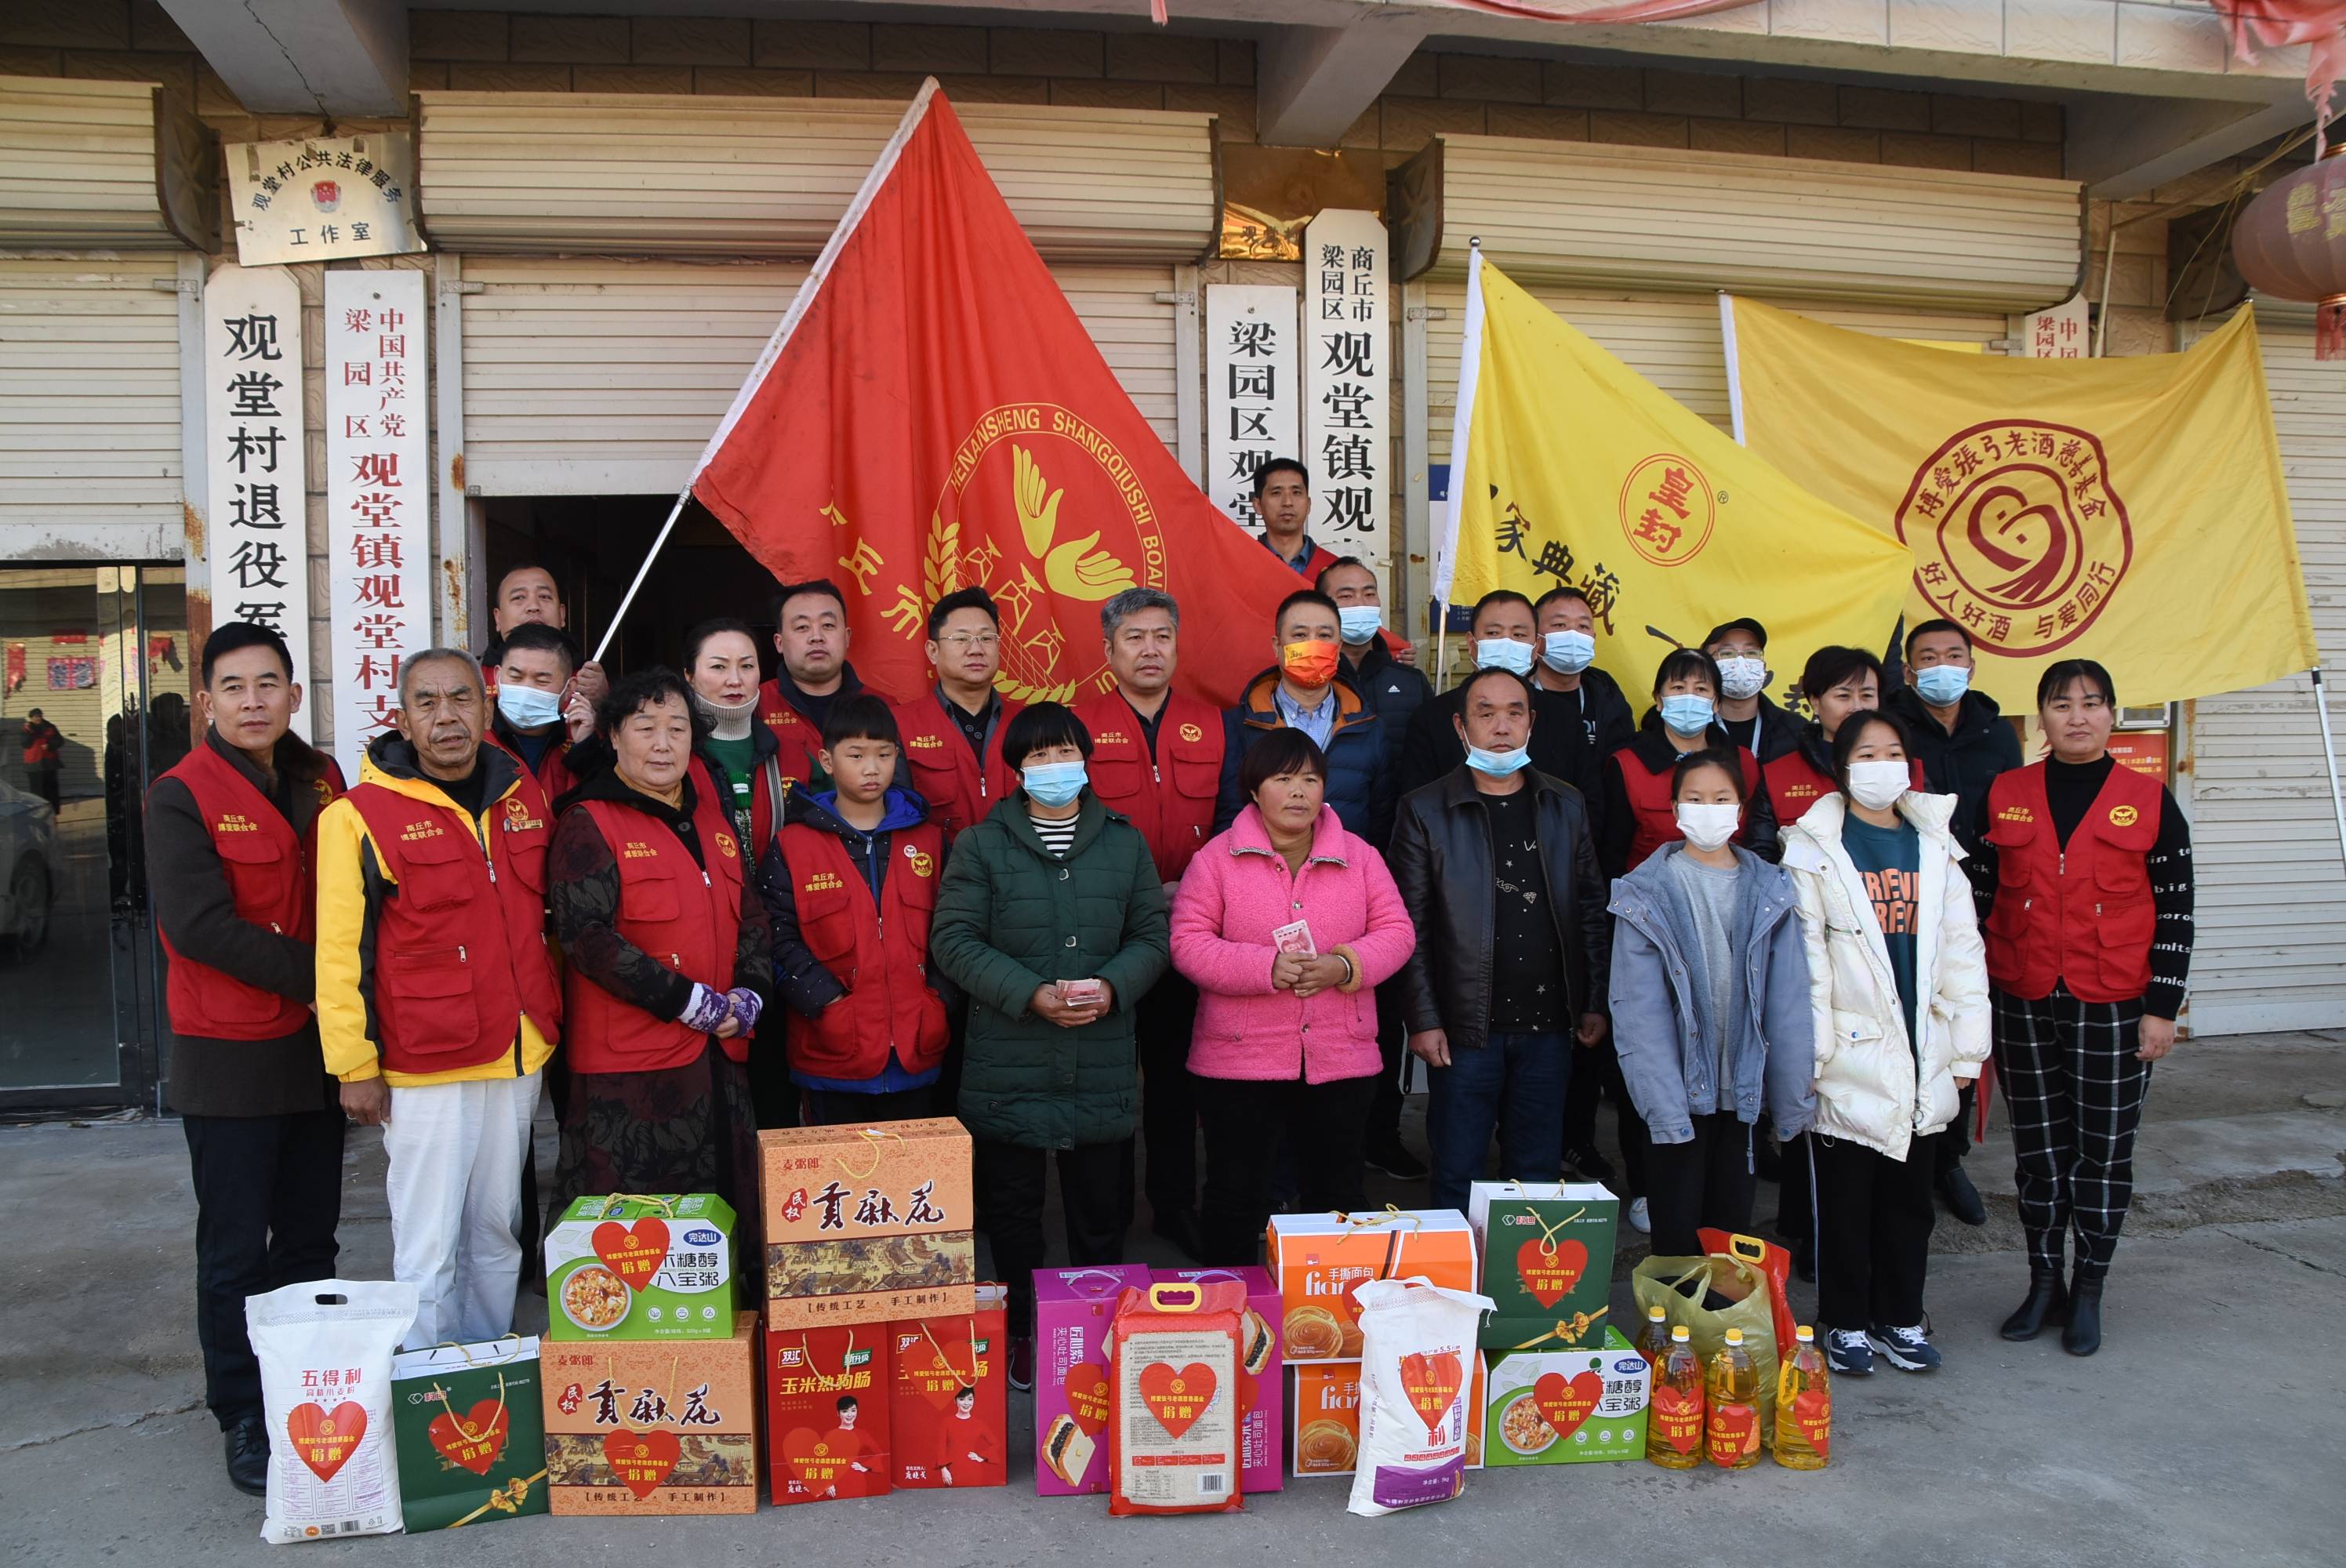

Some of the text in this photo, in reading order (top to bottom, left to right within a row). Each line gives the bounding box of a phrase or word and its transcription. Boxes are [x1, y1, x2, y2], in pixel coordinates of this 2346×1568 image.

[251, 150, 404, 211] 观堂村公共法律服务
[290, 222, 371, 245] 工作室
[1320, 244, 1346, 321] 梁园区
[1349, 246, 1375, 322] 商丘市
[343, 308, 372, 439] 梁园区
[379, 308, 406, 438] 中国共产党
[1320, 330, 1376, 557] 观堂镇观
[950, 408, 1164, 588] HENANSHENG SHANGQIUSHI BOAI
[1632, 467, 1696, 554] 皇封
[1490, 483, 1621, 637] 家典藏
[349, 452, 406, 758] 观堂镇观堂村支
[1920, 561, 2116, 642] 好人好酒 与爱同行
[910, 740, 943, 749] 博爱联合会
[401, 827, 445, 842] 博爱联合会
[405, 820, 432, 833] 商丘市
[805, 880, 844, 892] 博爱联合会
[812, 873, 835, 882] 商丘市
[784, 1191, 807, 1220] 民权
[812, 1180, 946, 1231] 贡麻花
[688, 1232, 717, 1243] 完达山
[621, 1259, 651, 1275] 捐赠
[657, 1271, 720, 1287] 八宝粥
[1536, 1279, 1563, 1291] 捐赠
[557, 1354, 594, 1367] 麦粥郎
[781, 1349, 801, 1363] 双汇
[1618, 1361, 1643, 1371] 完达山
[301, 1367, 361, 1387] 五得利
[779, 1370, 872, 1395] 玉米热狗肠
[927, 1379, 955, 1392] 捐赠
[561, 1384, 582, 1412] 民权
[587, 1379, 721, 1426] 贡麻花
[1421, 1396, 1443, 1410] 捐赠
[1078, 1403, 1109, 1422] 捐赠
[1163, 1405, 1192, 1419] 捐赠
[1553, 1410, 1581, 1422] 捐赠
[1253, 1410, 1264, 1468] 夹心吐司面包
[1670, 1425, 1697, 1438] 捐赠
[310, 1447, 342, 1462] 捐赠
[462, 1441, 493, 1461] 捐赠
[1712, 1440, 1737, 1453] 捐赠
[627, 1468, 657, 1481] 捐赠
[804, 1468, 834, 1480] 捐赠
